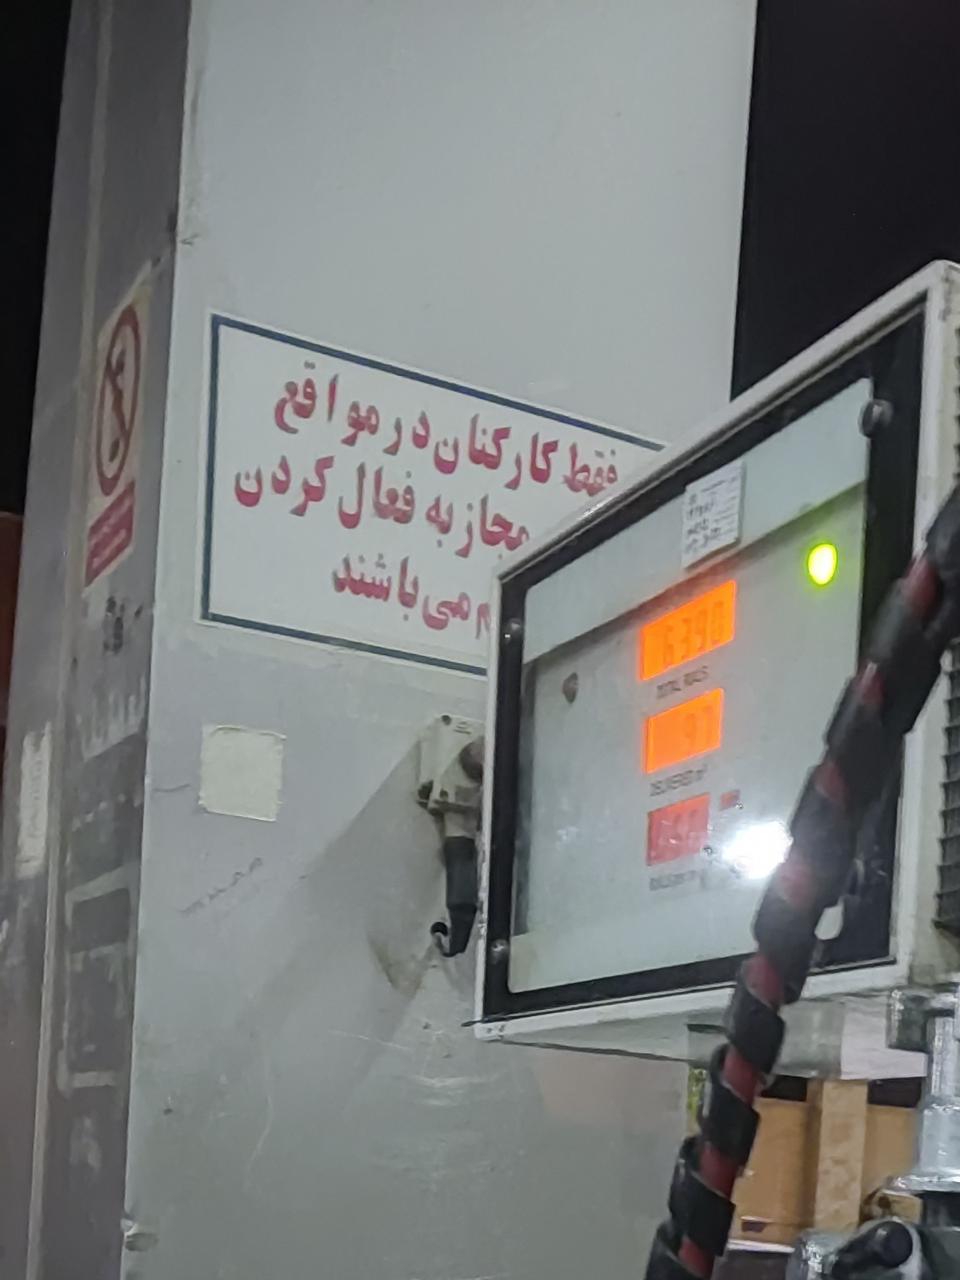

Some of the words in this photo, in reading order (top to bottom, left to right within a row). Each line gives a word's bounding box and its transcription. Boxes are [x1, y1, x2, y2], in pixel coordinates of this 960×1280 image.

[275, 361, 379, 447] مواقع
[383, 411, 430, 456] در
[434, 413, 559, 490] کارکنان
[563, 442, 617, 497] فقط
[235, 455, 334, 516] کردن
[338, 462, 415, 529] فعال
[426, 495, 453, 548] به
[455, 494, 530, 559] مجاز
